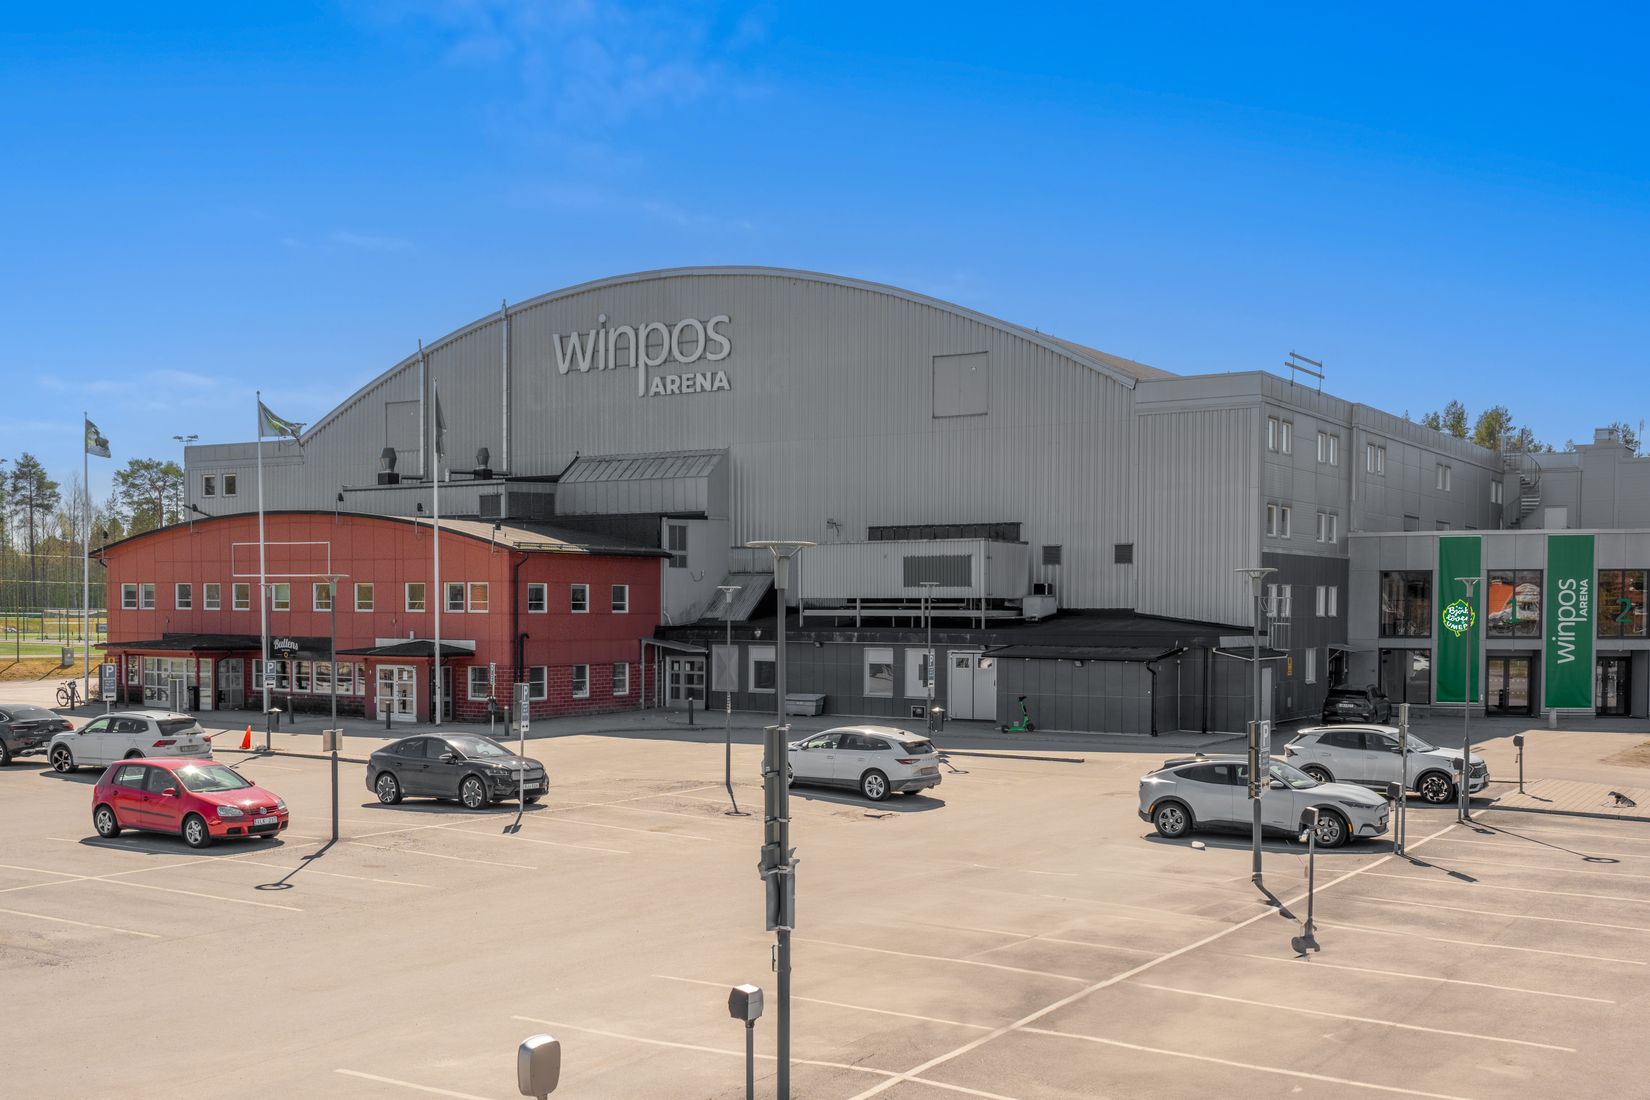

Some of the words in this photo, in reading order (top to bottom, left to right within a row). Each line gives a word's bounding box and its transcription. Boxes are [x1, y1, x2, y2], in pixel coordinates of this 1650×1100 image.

[552, 313, 732, 397] winpos
[650, 371, 731, 396] ARENA
[1579, 578, 1589, 617] ARENA
[1505, 598, 1521, 623] 1
[1552, 578, 1588, 664] winpos
[1616, 598, 1632, 623] 2
[273, 638, 298, 651] Bullens
[106, 665, 114, 677] P
[267, 662, 274, 673] P
[523, 685, 528, 701] P
[1262, 724, 1269, 747] P
